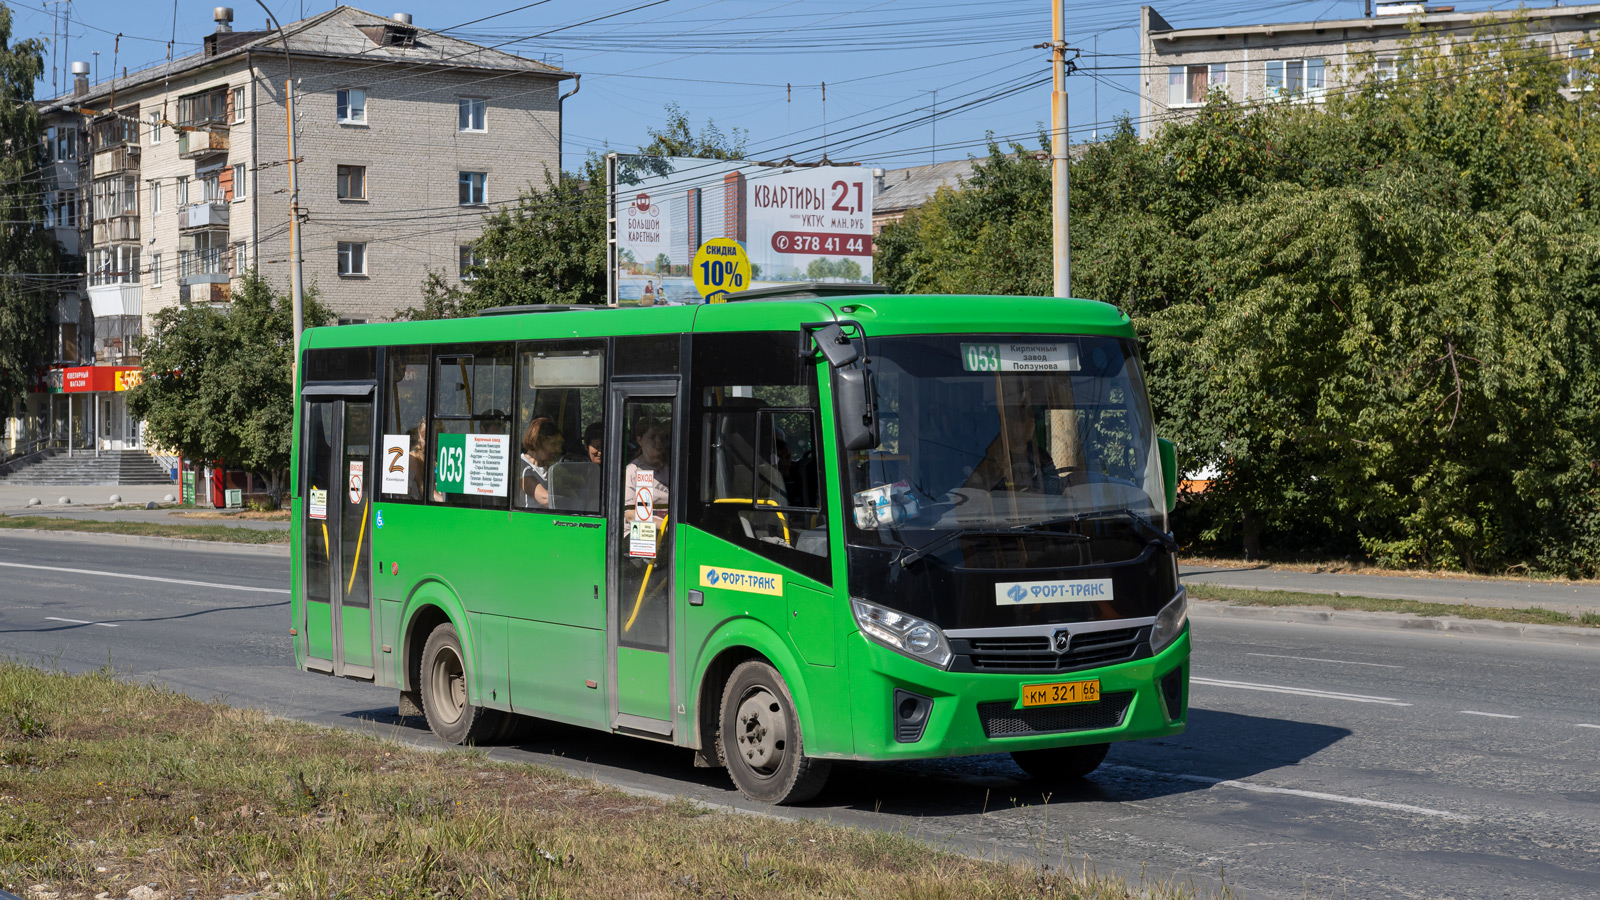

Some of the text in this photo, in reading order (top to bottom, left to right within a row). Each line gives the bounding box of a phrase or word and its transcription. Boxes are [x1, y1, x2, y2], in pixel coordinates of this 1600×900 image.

[754, 180, 863, 215] КВАРТИРЫ 2,1
[628, 217, 660, 230] БОЛЬШОЙ
[802, 214, 825, 228] УКТУС
[831, 218, 849, 229] МЛН.
[851, 218, 864, 230] РУБ
[628, 230, 660, 242] КАРЕТНЫЙ
[706, 245, 737, 257] СКИДКА
[794, 236, 863, 252] 378 41 44
[700, 260, 743, 288] 10%
[1010, 344, 1058, 353] Кирпичный
[968, 345, 999, 372] 053
[1023, 354, 1048, 362] завод
[1013, 362, 1058, 371] Ползунова
[66, 369, 89, 380] ЮВЕЛИРНЫЙ
[69, 380, 86, 388] МАГАЗИН
[439, 446, 463, 483] 053
[637, 473, 653, 483] ВХОД
[721, 571, 776, 590] ФОРТ-ТРАНС
[1030, 583, 1105, 598] ФОРТ-ТРАНС
[1030, 682, 1095, 703] КМ 321 66
